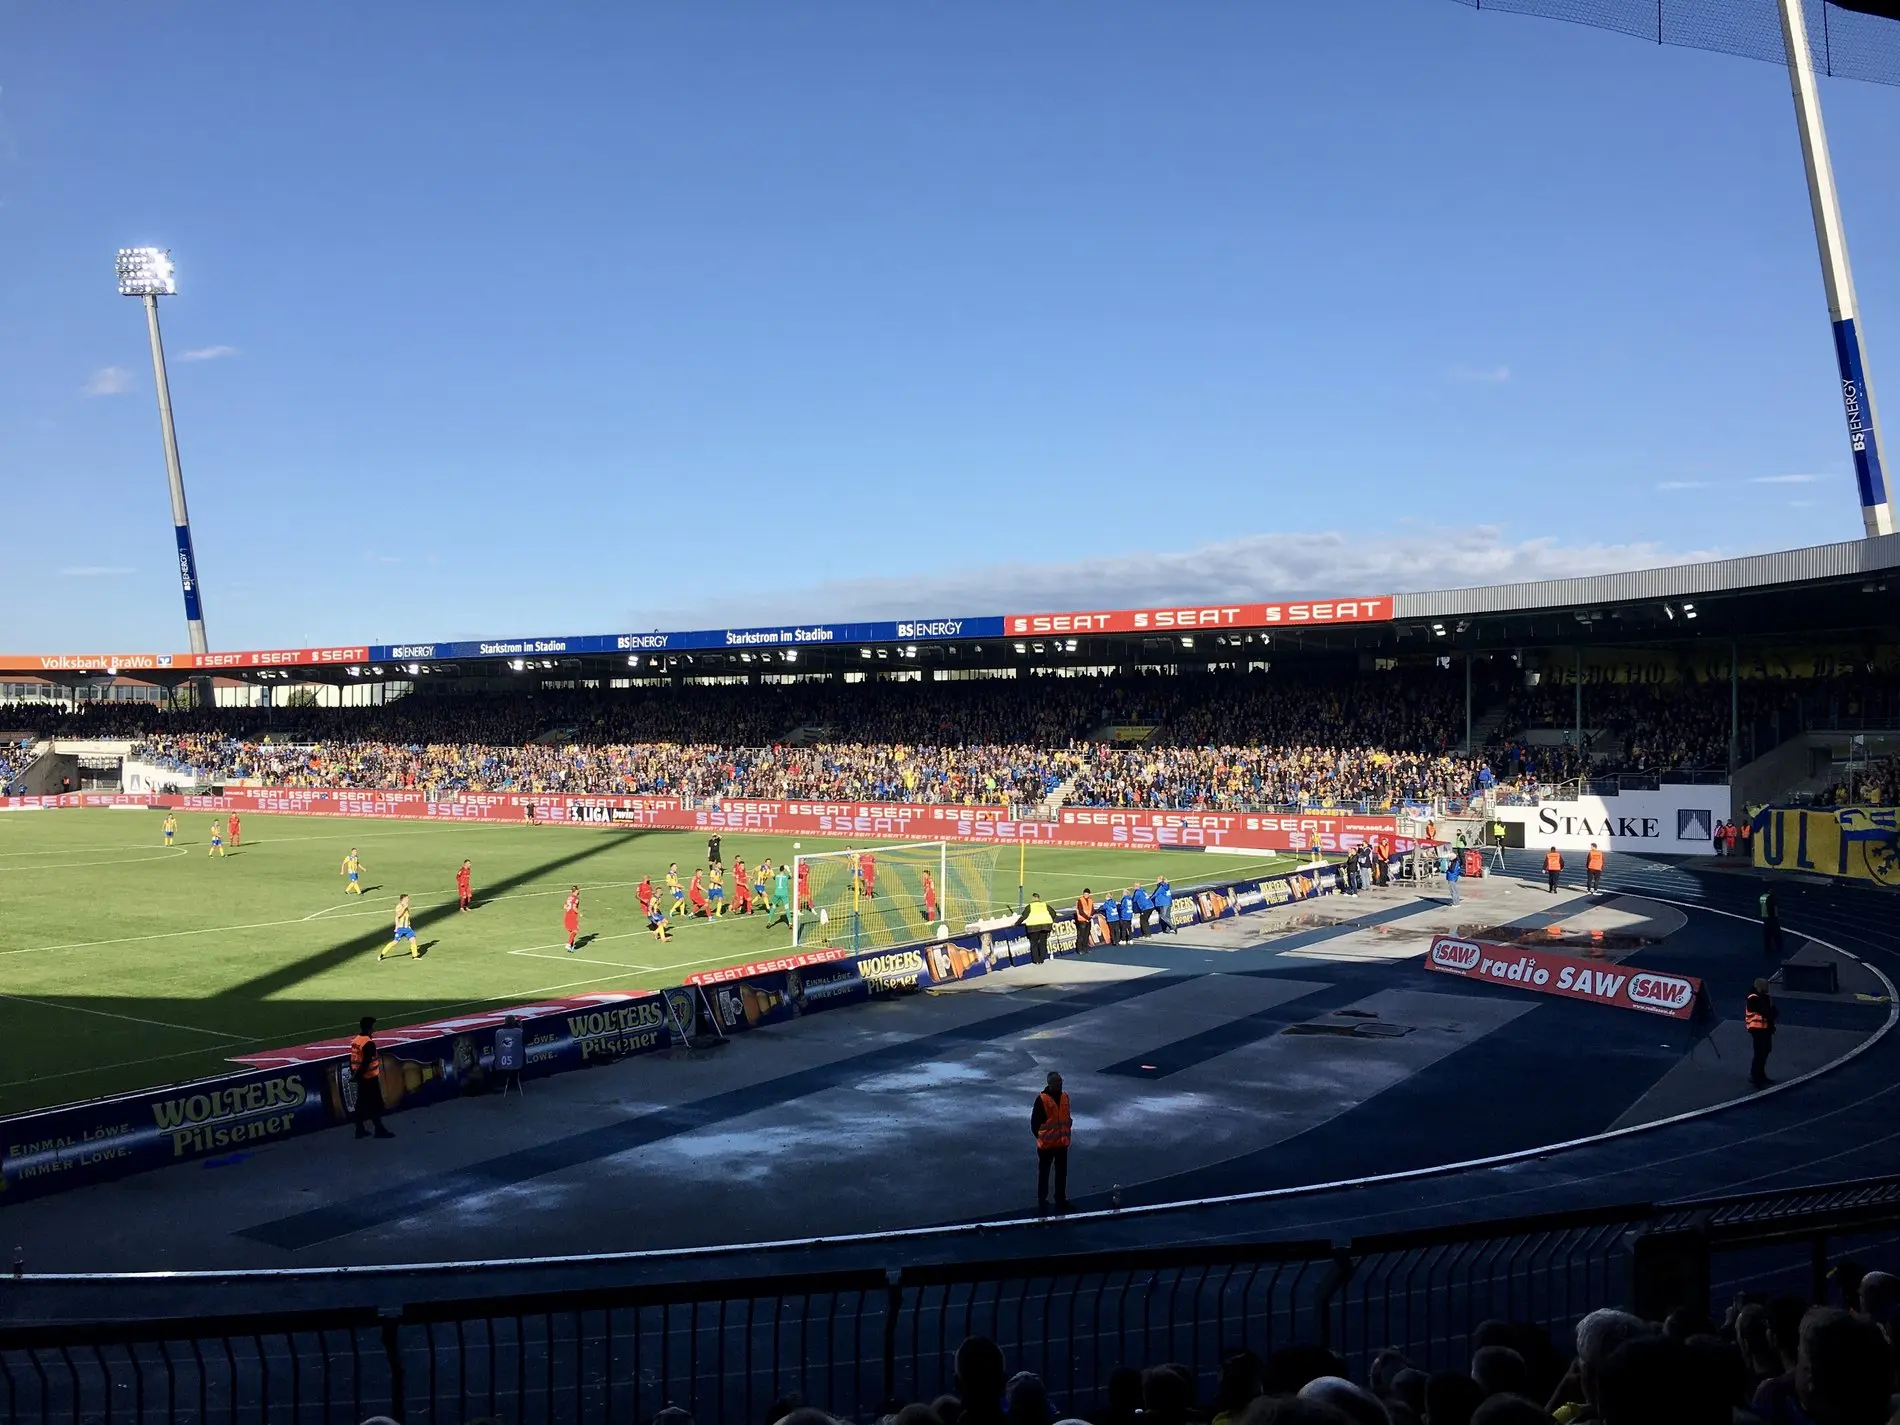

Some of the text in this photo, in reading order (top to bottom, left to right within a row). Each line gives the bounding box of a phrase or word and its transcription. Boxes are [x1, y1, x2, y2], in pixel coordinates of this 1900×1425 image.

[1155, 608, 1241, 626] SEAT
[1288, 601, 1381, 620] SEAT
[1033, 615, 1111, 631] SEAT
[727, 628, 833, 645] Starkstrom im Stadion
[322, 649, 364, 661] SEAT
[480, 640, 566, 654] Starkstrom im Stadion
[41, 656, 152, 668] Volksbank BraWo
[205, 655, 241, 666] SEAT
[261, 652, 301, 664] SEAT
[252, 790, 284, 798] SEAT
[338, 792, 374, 801] SEAT
[471, 795, 506, 806] SEAT
[195, 797, 233, 808] SEAT
[267, 799, 312, 811] SEAT
[350, 801, 398, 814] SEAT
[443, 804, 492, 817] SEAT
[734, 802, 782, 814] SEAT
[800, 804, 852, 817] SEAT
[571, 806, 610, 823] 3. LIGA
[612, 808, 634, 820] bwin
[710, 812, 778, 827] SEAT
[870, 805, 925, 818] SEAT
[835, 816, 910, 833] SEAT
[1077, 813, 1142, 827] SEAT
[1261, 819, 1336, 832] SEAT
[1539, 807, 1660, 837] STAAKE
[976, 821, 1059, 838] SEAT
[1132, 826, 1229, 845] SEAT
[807, 950, 842, 966] SEAT
[1439, 944, 1477, 965] SAW
[757, 958, 794, 976] SEAT
[857, 950, 923, 978] WOLTERS
[704, 968, 744, 985] SEAT
[1480, 956, 1627, 997] radio SAW
[866, 974, 918, 996] Pilsener
[1636, 979, 1687, 1003] SAW
[566, 1001, 664, 1039] WOLTERS
[580, 1030, 658, 1060] Pilsener
[500, 1055, 513, 1066] 05
[151, 1074, 307, 1130] WOLTERS
[170, 1110, 296, 1157] Pilsener
[9, 1135, 76, 1158] EINMAL
[18, 1159, 74, 1181] IMMER
